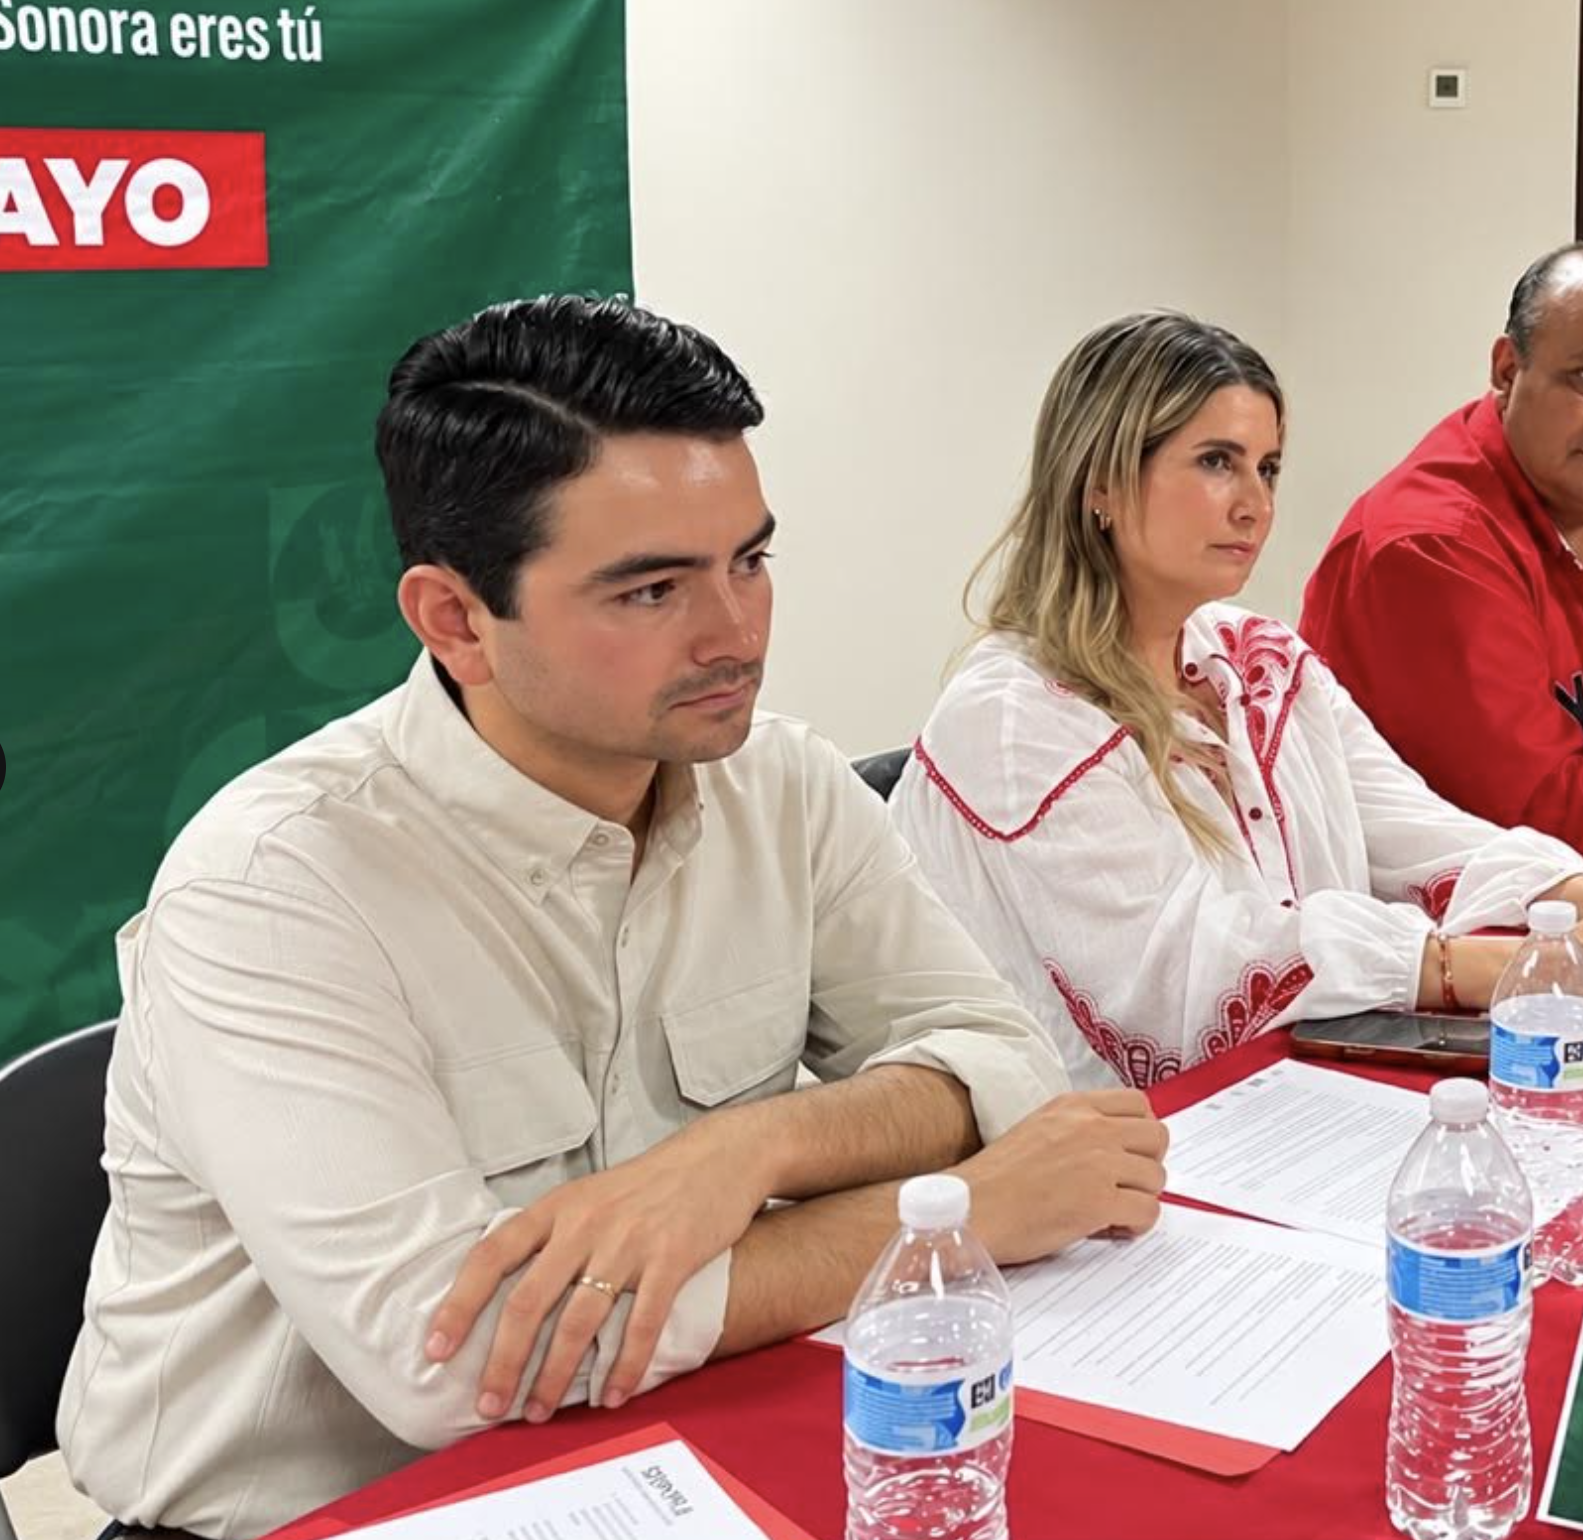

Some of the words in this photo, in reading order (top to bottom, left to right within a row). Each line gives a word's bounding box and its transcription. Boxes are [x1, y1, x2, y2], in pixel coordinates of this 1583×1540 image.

[0, 0, 159, 56] Sonora
[169, 12, 271, 60] eres
[277, 6, 323, 62] tú
